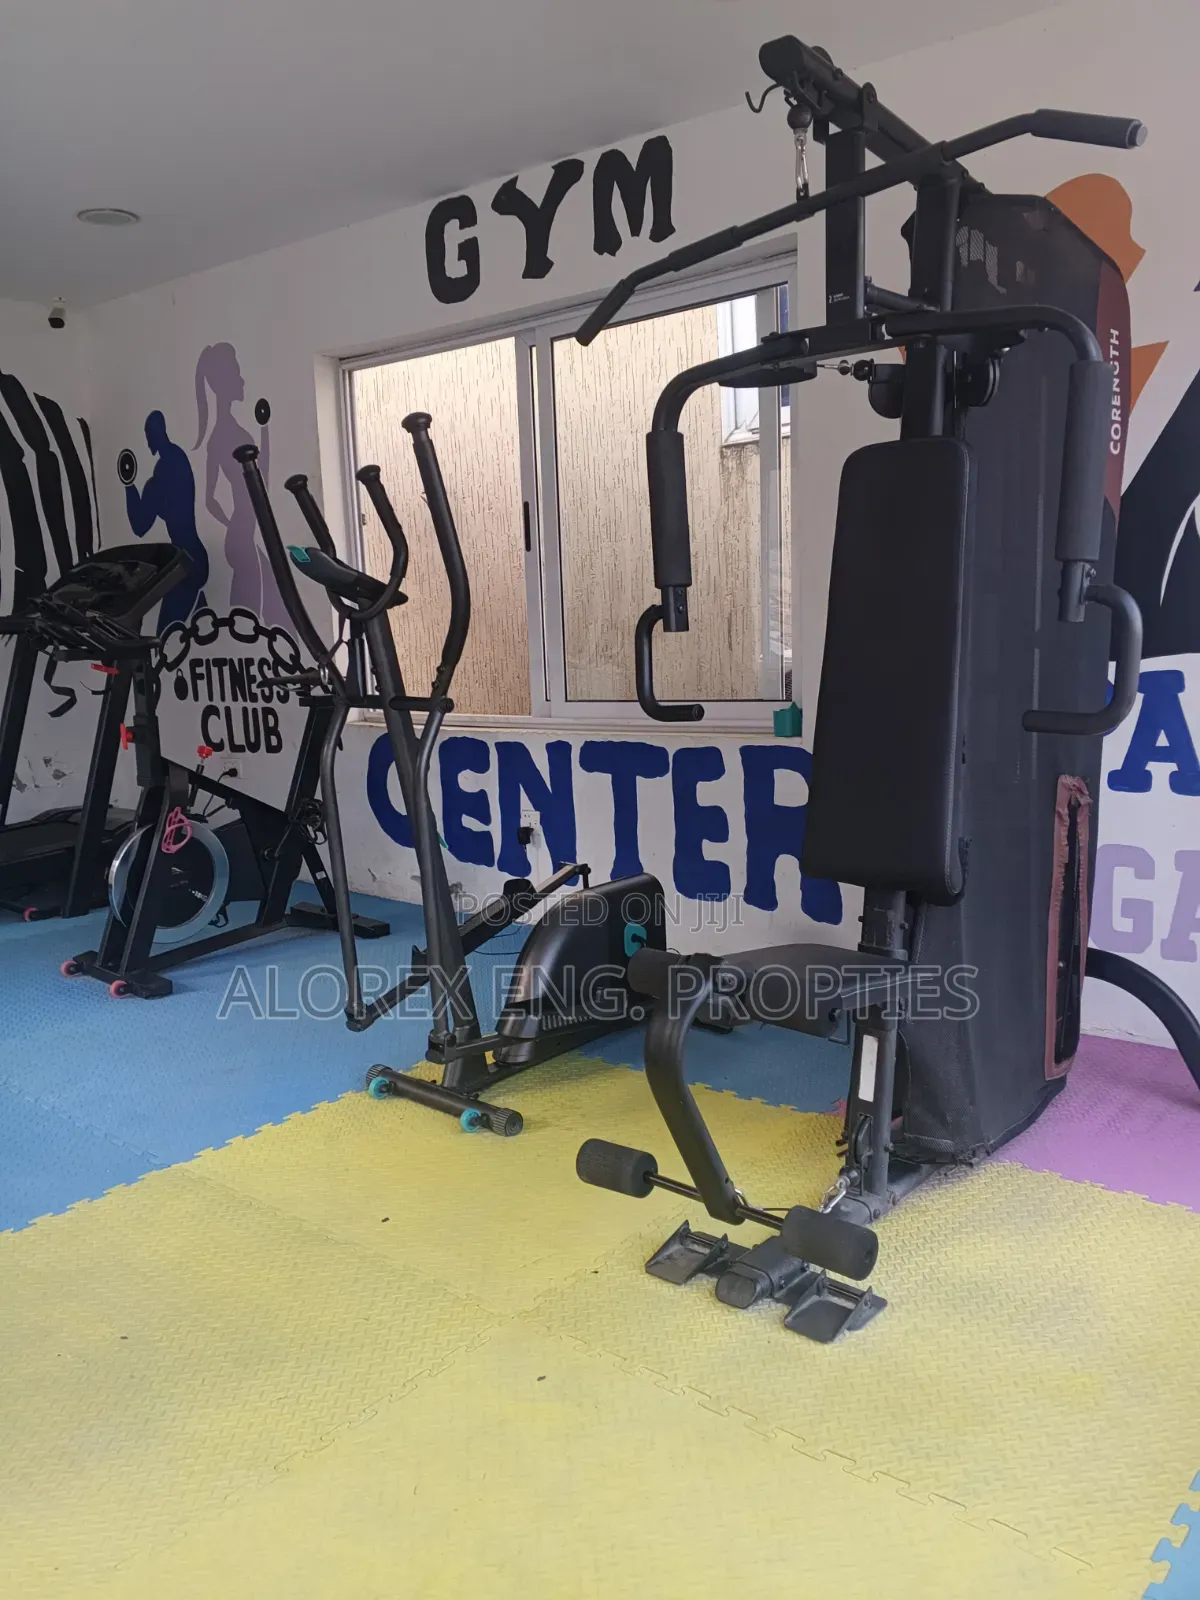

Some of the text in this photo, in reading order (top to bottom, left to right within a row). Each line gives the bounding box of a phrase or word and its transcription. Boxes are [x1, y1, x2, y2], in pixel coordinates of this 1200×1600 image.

[425, 135, 676, 304] GYM
[189, 657, 291, 704] FITNESS
[201, 704, 283, 753] CLUB
[366, 731, 844, 926] CENTER
